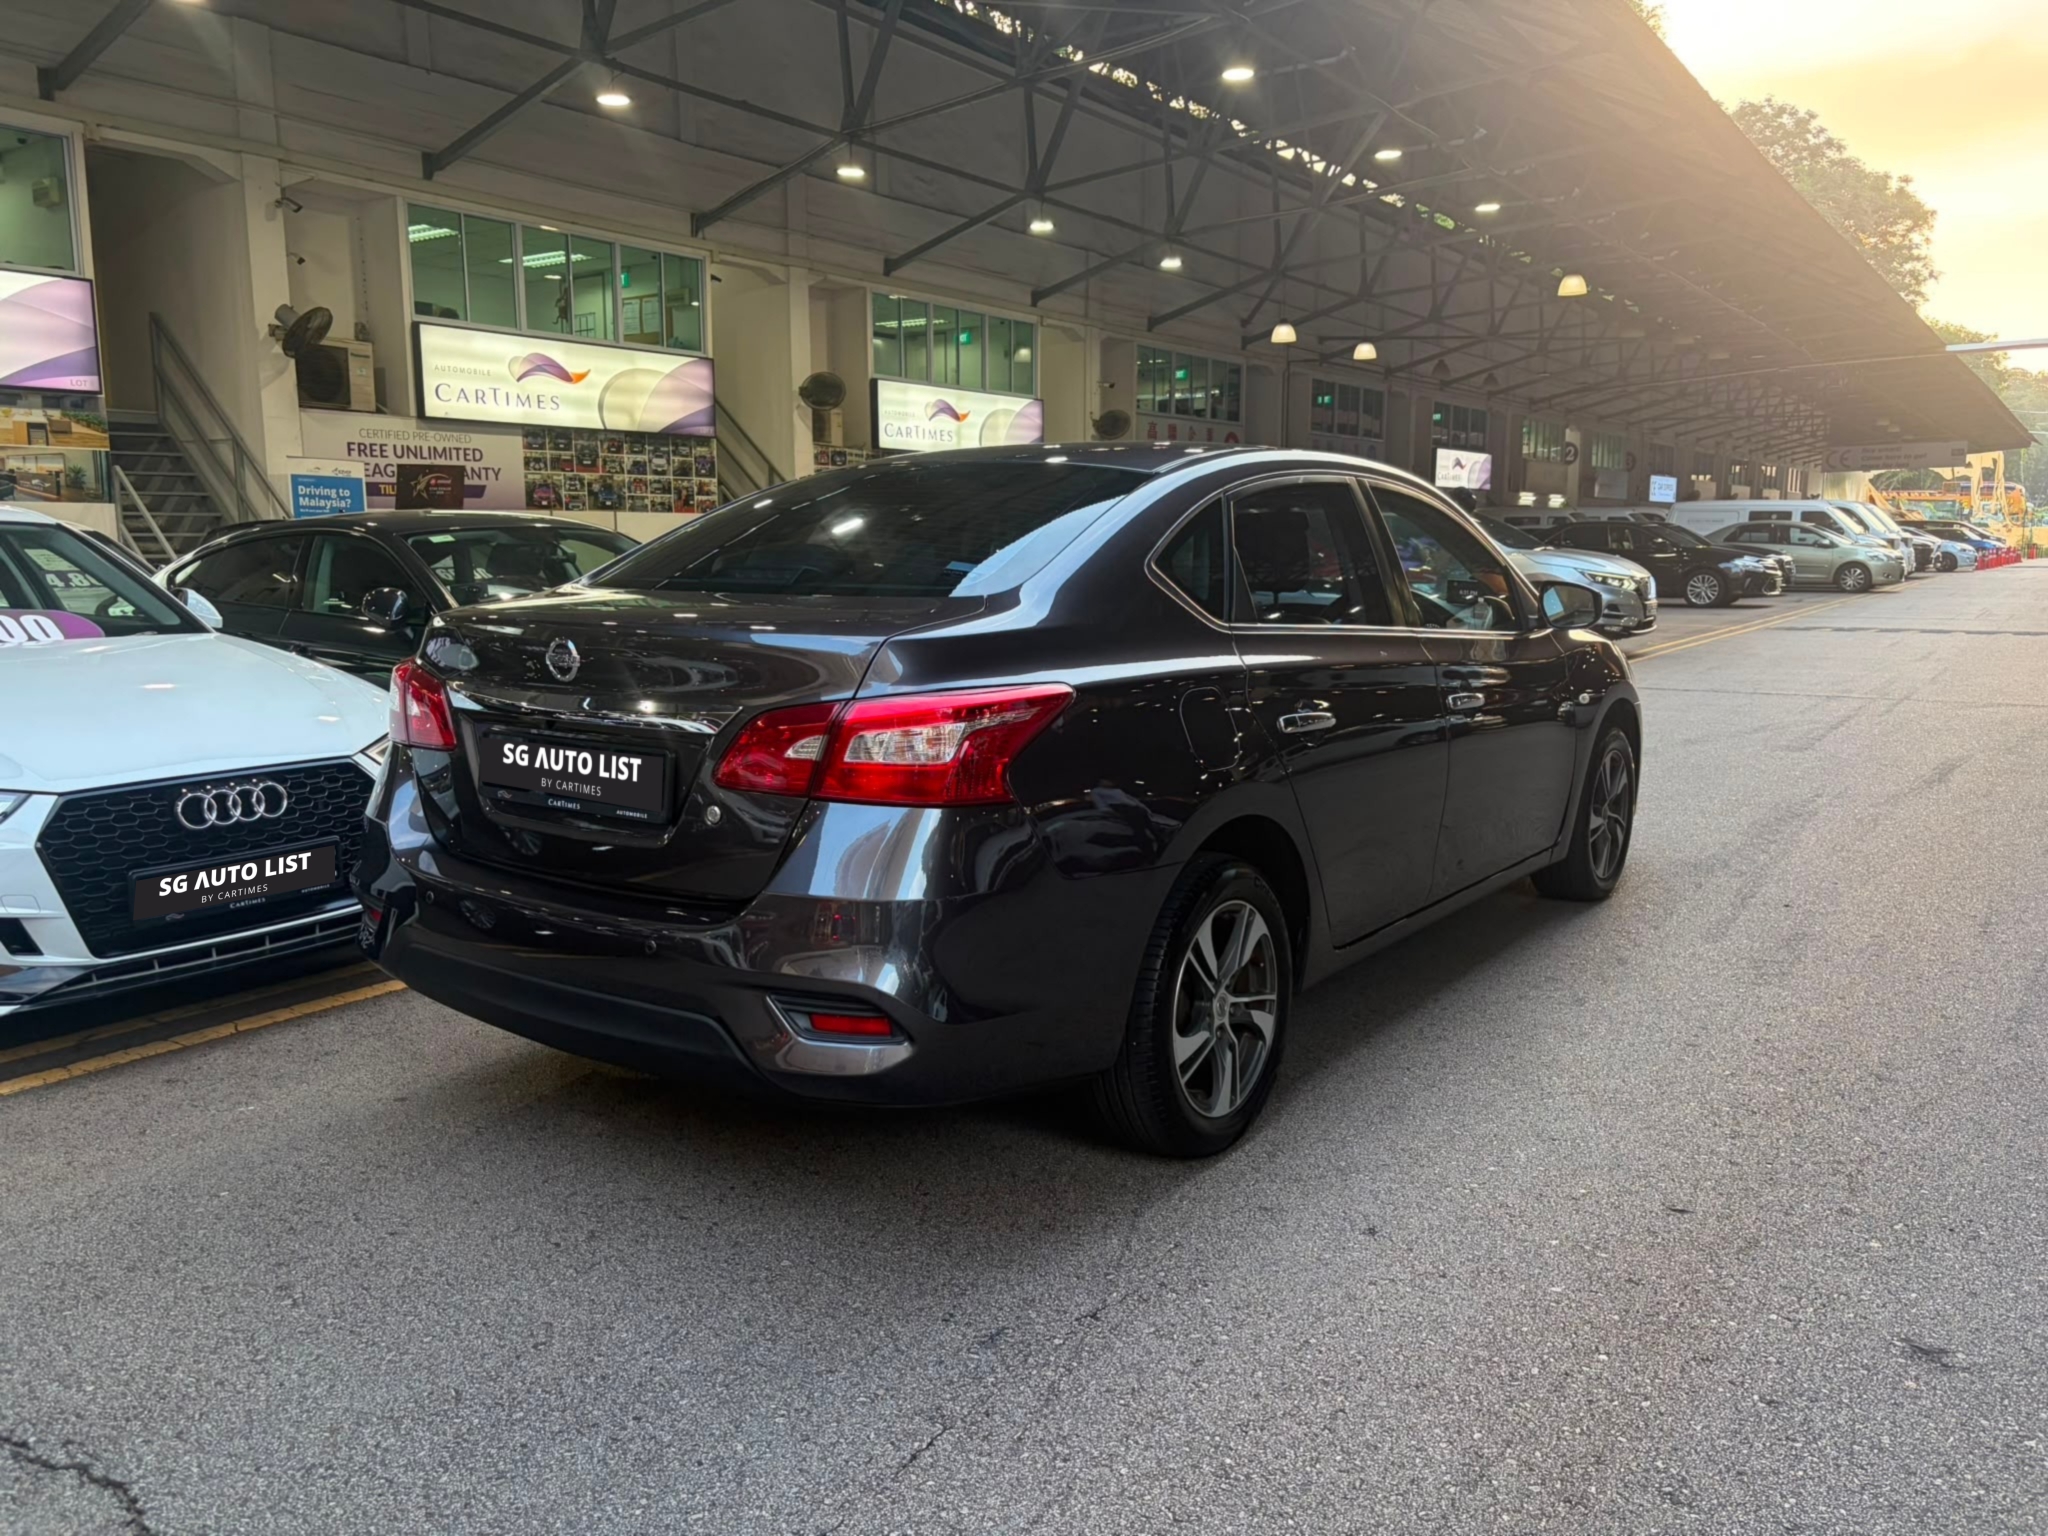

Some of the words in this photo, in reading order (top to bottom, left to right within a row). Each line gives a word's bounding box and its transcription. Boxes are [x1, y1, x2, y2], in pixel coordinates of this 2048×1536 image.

[434, 364, 492, 377] AUTOMOBILE
[69, 378, 88, 387] LOT
[434, 382, 560, 411] CARTIMES
[358, 427, 410, 442] CERTIFIED
[412, 429, 472, 444] PRE-OWNED
[884, 422, 954, 443] CARTIMES
[346, 441, 389, 459] FREE
[393, 443, 484, 463] UNLIMITED
[1565, 445, 1575, 460] 2
[364, 462, 396, 478] EAG
[464, 466, 502, 481] ANTY
[297, 485, 337, 499] Driving
[339, 488, 351, 497] to
[298, 497, 352, 509] Malaysia?
[547, 798, 581, 810] CARTIMES
[616, 809, 648, 819] AUTOMOBILE
[229, 896, 266, 910] CARTIMES
